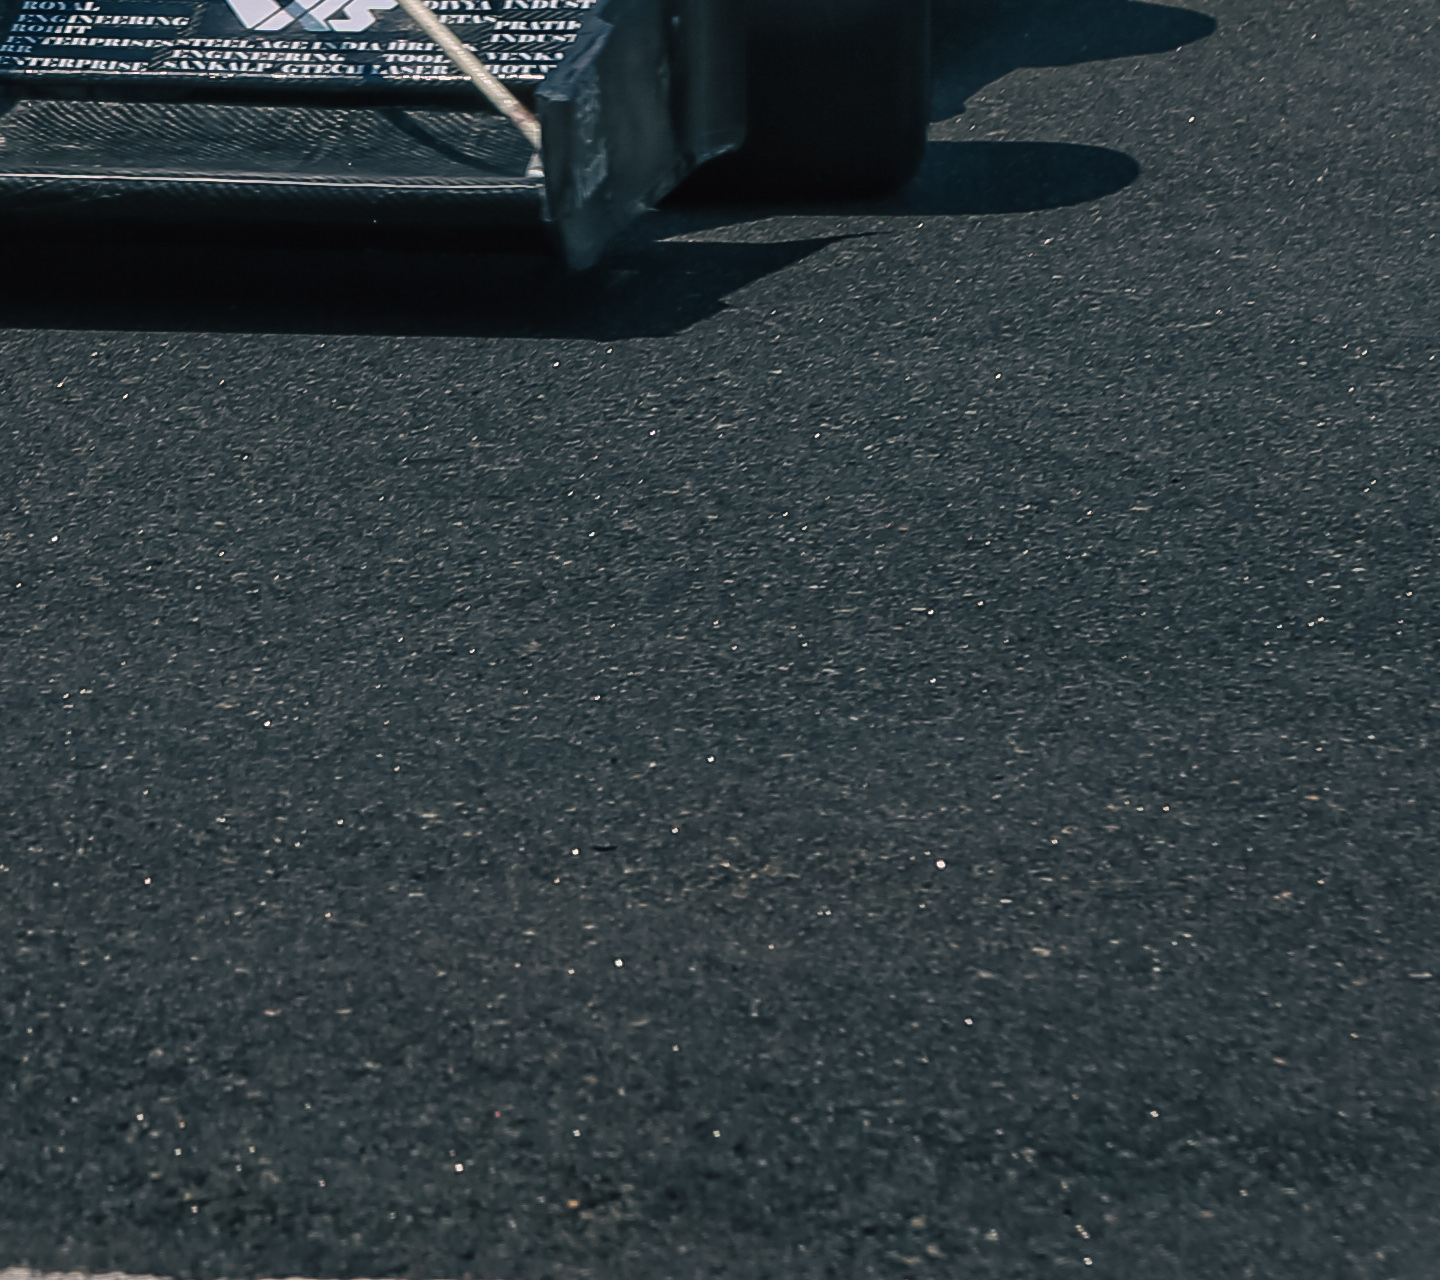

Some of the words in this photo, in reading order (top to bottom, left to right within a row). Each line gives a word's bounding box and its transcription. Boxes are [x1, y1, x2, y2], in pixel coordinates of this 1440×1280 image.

[22, 1, 101, 12] ROYAL
[18, 14, 191, 26] ENGINEERING
[5, 36, 173, 48] ENTERPRISES
[310, 41, 382, 51] INDIA
[171, 49, 346, 62] ENGINEERING
[162, 60, 274, 72] SANKALP
